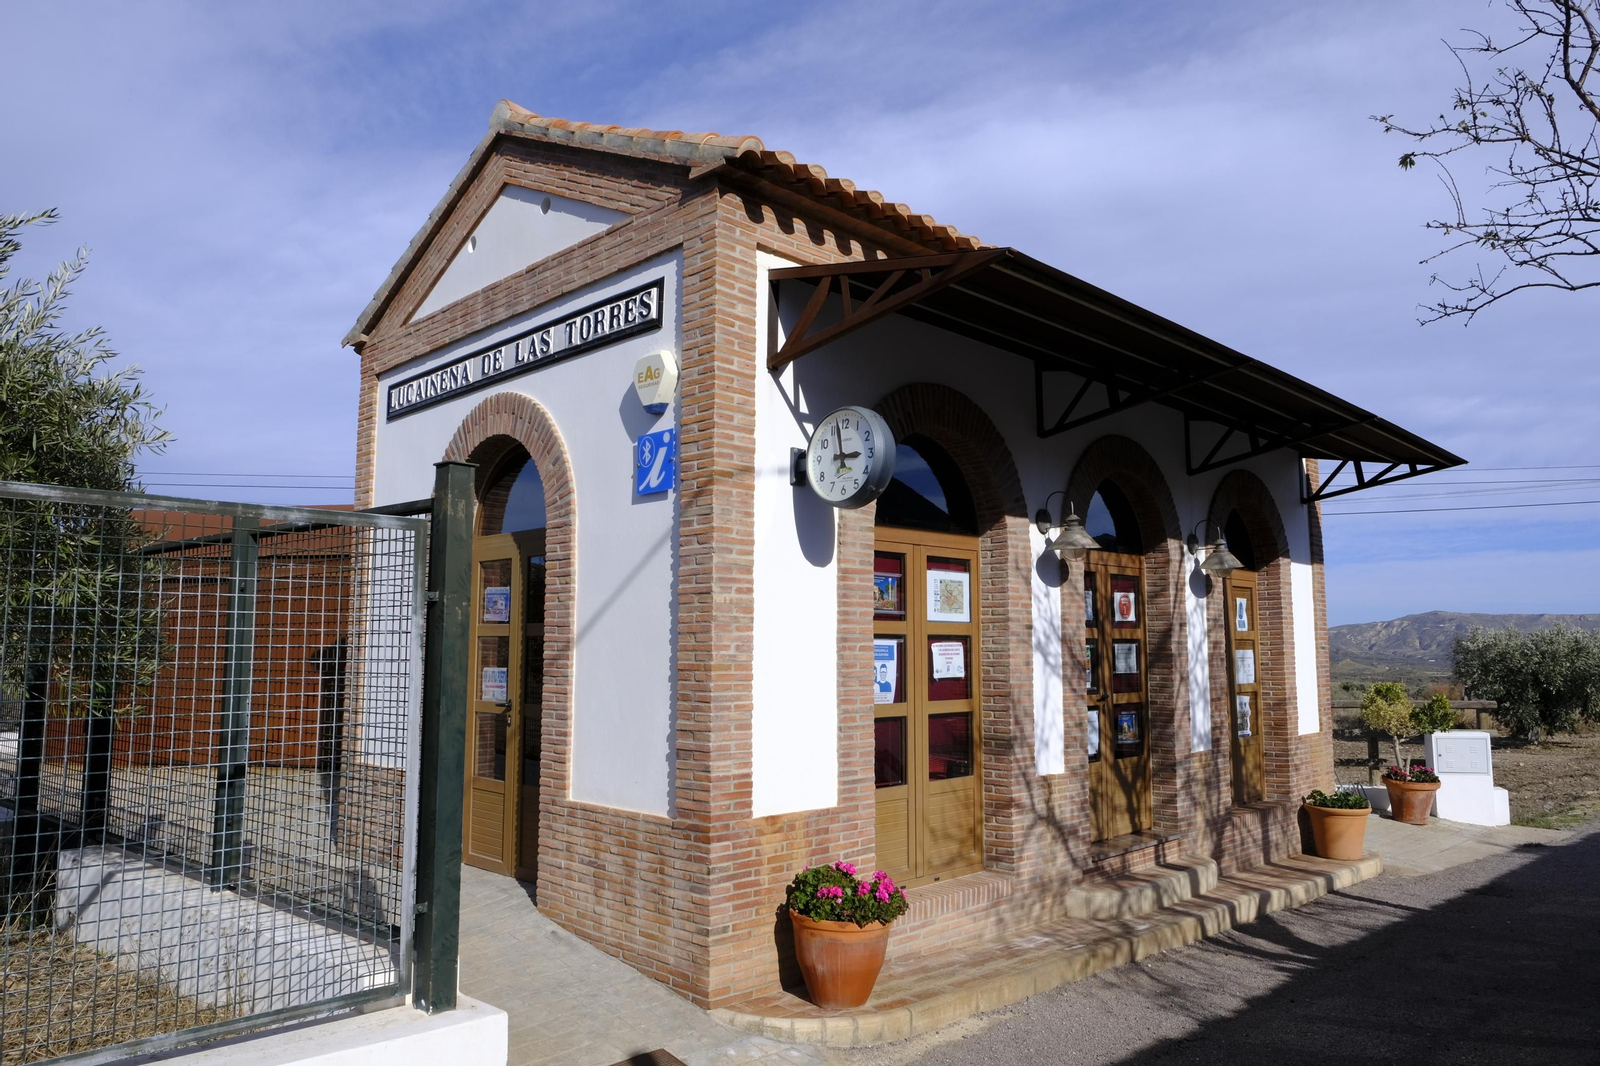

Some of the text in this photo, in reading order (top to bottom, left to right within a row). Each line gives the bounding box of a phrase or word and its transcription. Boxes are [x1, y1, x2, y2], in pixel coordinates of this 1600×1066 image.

[390, 291, 652, 408] LUCAINENA DE LAS TORRES
[638, 365, 660, 383] EAG
[842, 418, 850, 430] 12
[831, 426, 836, 436] 11
[864, 431, 870, 442] 2
[821, 439, 828, 449] 10
[868, 448, 874, 458] 3
[817, 455, 822, 465] 9
[863, 465, 868, 476] 4
[820, 472, 825, 482] 8
[830, 482, 835, 492] 7
[854, 479, 859, 490] 5
[841, 485, 846, 495] 6
